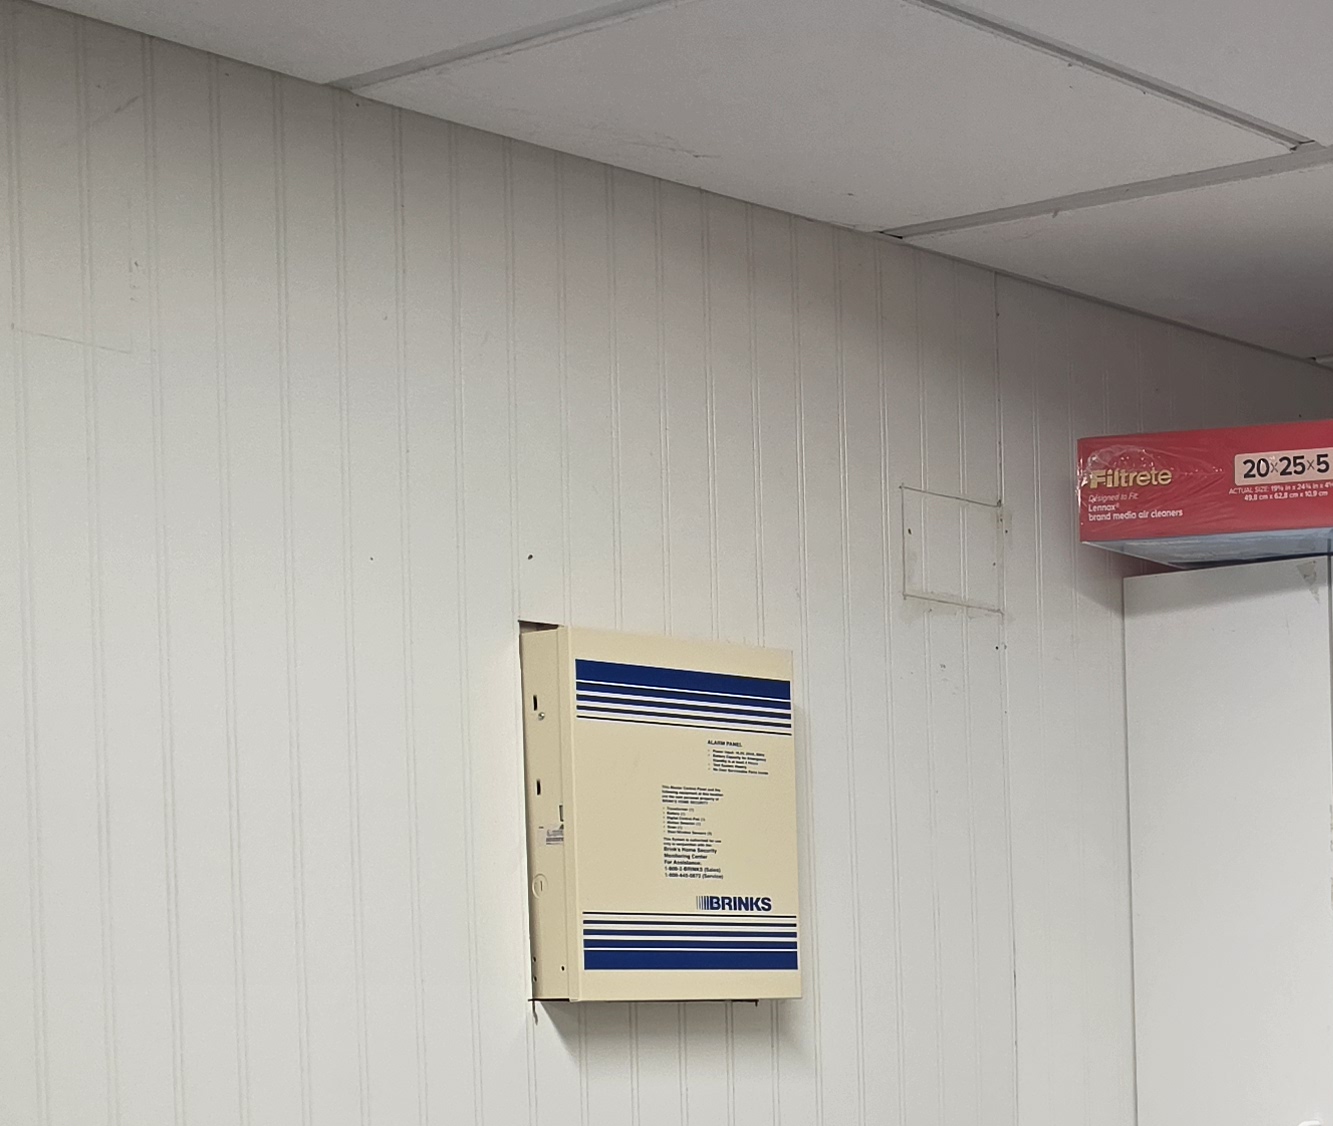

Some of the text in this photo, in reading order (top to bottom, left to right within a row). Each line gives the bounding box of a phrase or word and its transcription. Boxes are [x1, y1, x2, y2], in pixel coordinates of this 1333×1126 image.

[1089, 467, 1172, 489] Filtrete
[1088, 509, 1183, 521] brand media air cleaners
[709, 895, 772, 912] BRINKS
